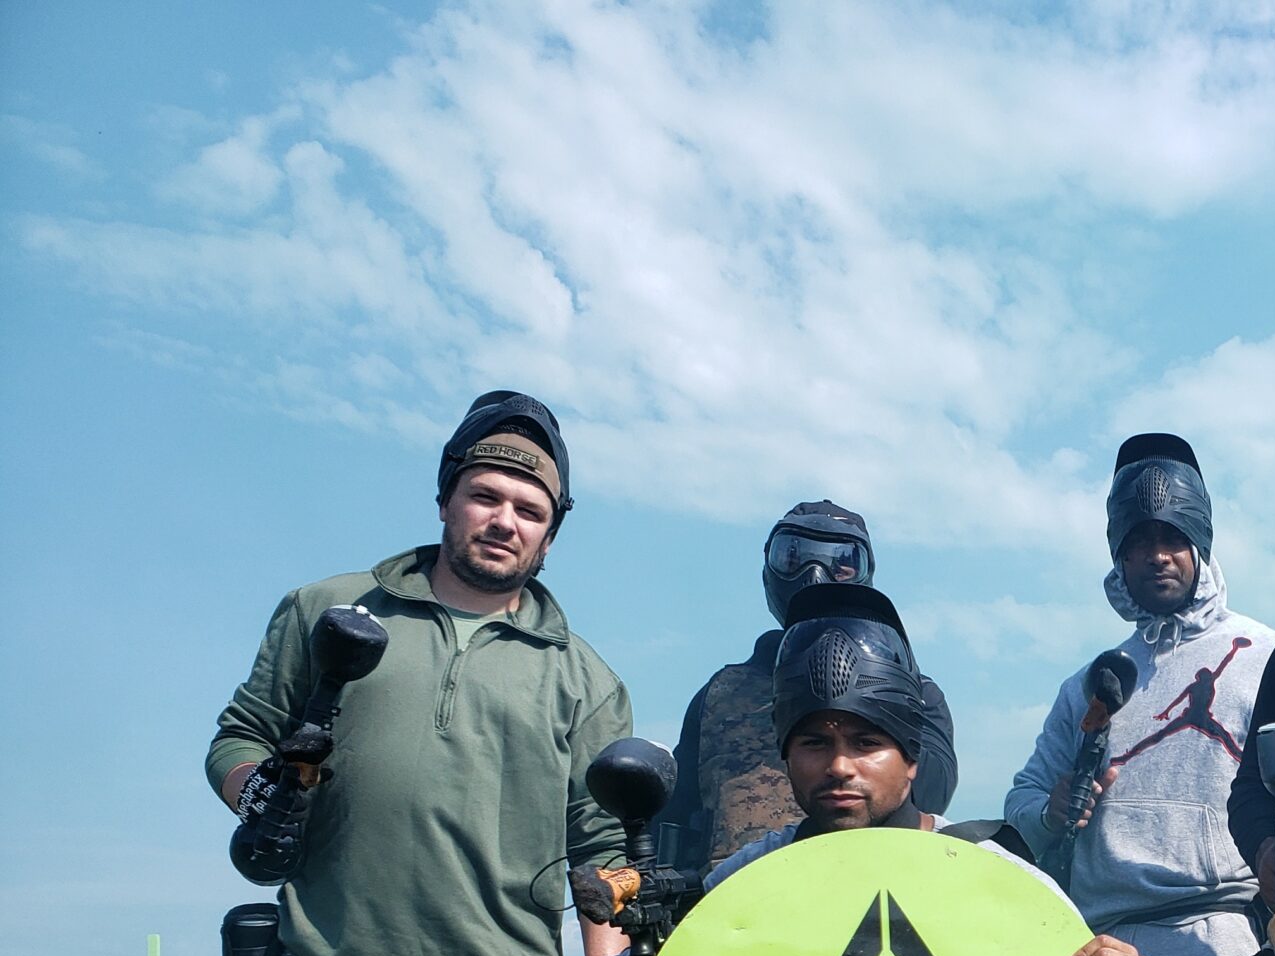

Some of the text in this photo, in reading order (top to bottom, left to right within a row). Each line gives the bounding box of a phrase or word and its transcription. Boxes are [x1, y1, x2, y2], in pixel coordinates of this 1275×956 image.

[477, 445, 536, 464] RED HORSE
[237, 772, 268, 824] Mechanix
